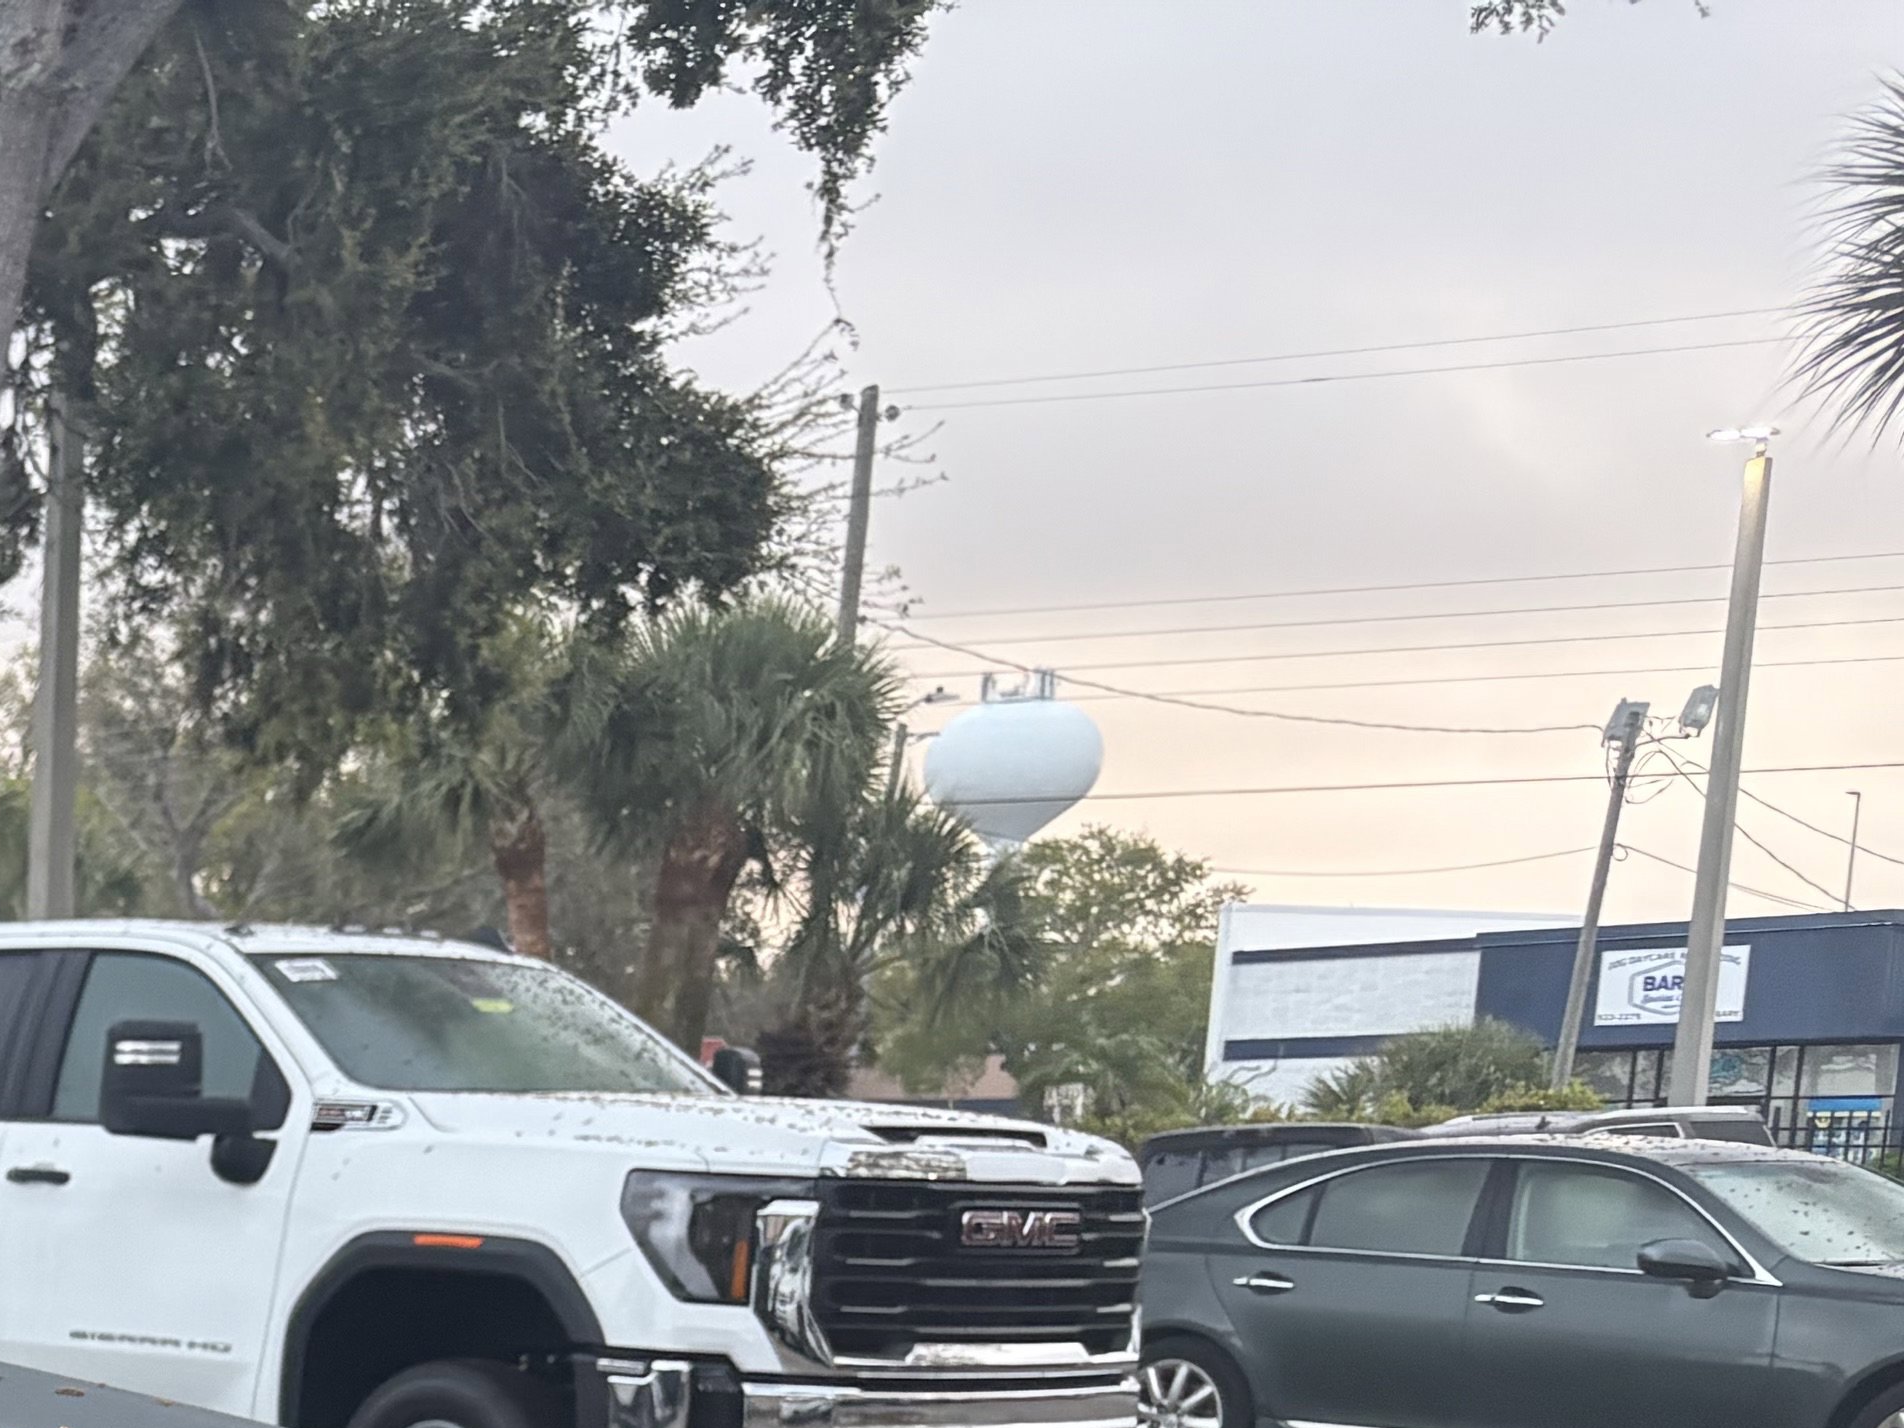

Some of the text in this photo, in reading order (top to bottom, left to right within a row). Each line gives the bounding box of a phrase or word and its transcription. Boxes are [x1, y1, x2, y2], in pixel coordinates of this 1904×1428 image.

[1643, 975, 1683, 991] BAR
[961, 1211, 1080, 1247] GMC
[69, 1330, 181, 1348] SIERRA
